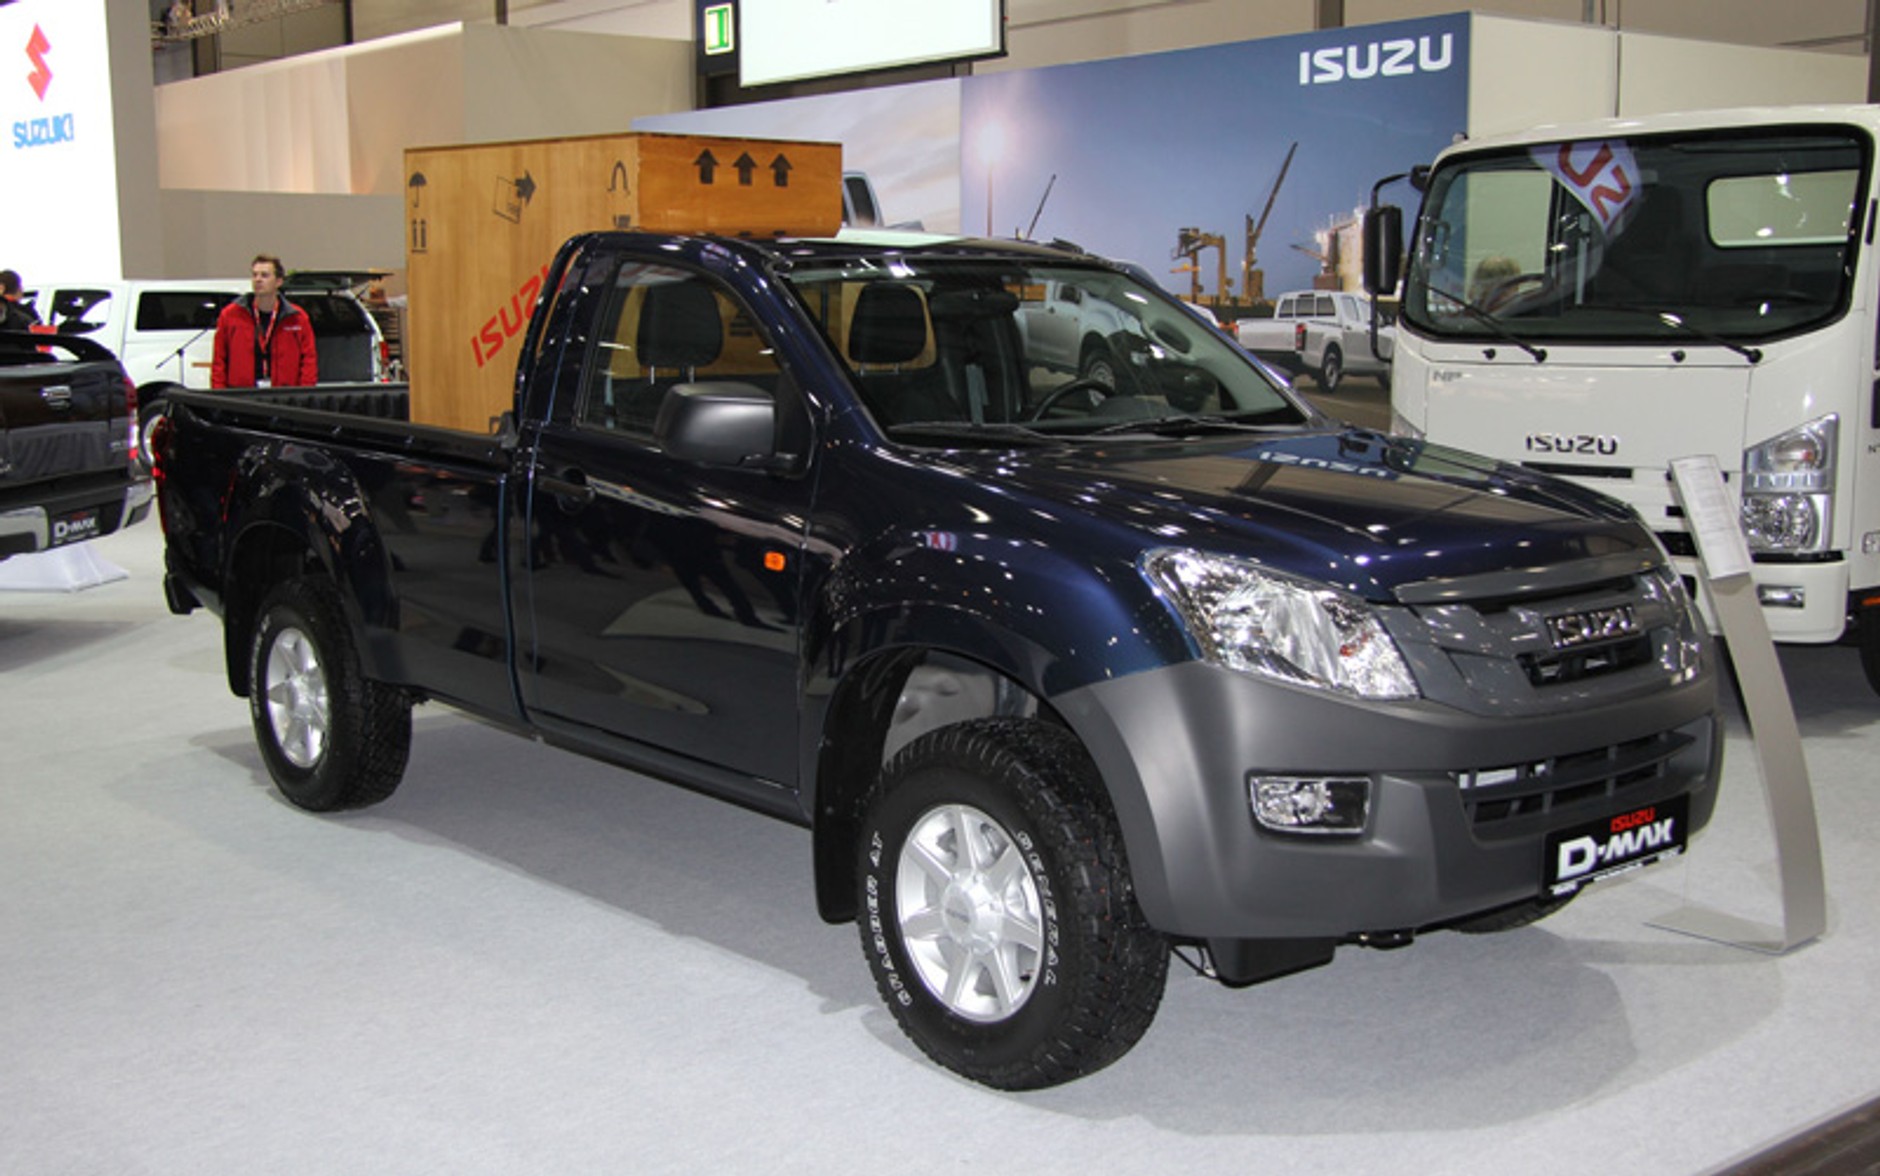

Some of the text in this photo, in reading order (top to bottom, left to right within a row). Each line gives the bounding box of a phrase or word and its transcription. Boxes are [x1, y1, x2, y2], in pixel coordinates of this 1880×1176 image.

[1299, 33, 1453, 85] ISUZU
[13, 113, 75, 149] SUZUKI
[1525, 434, 1619, 456] ISUZU
[1546, 606, 1638, 648] ISUZU
[1610, 806, 1657, 833] ISUZU
